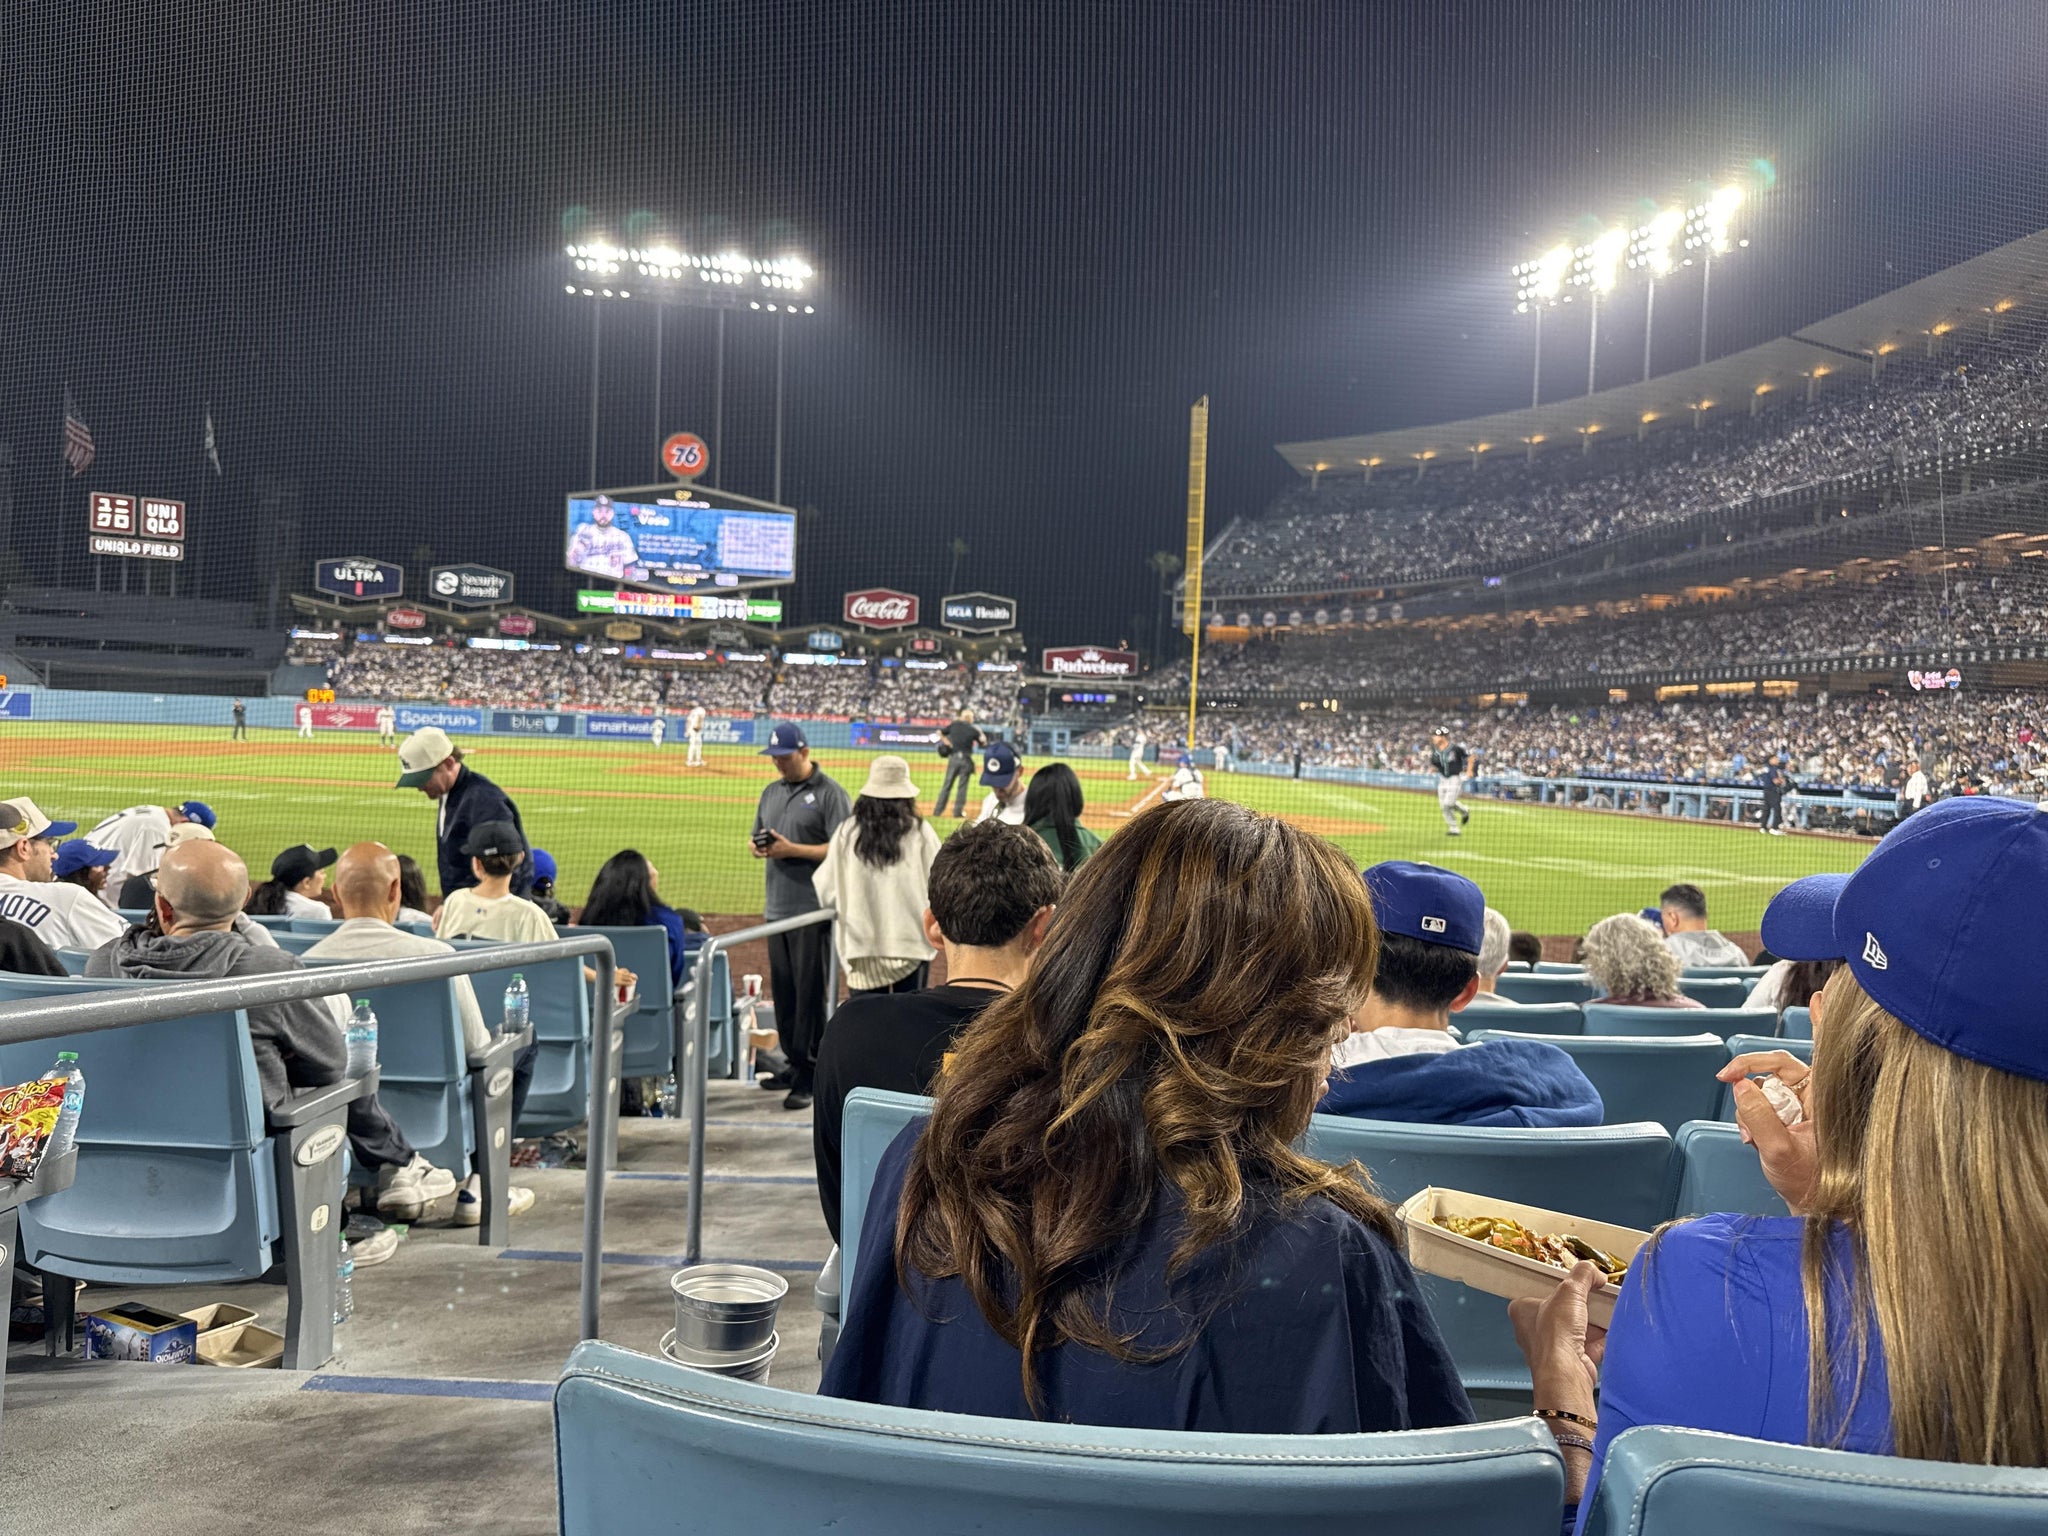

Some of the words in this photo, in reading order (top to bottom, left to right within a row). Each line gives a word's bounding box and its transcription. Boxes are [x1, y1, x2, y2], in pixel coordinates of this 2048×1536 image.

[670, 444, 701, 467] 76
[146, 503, 177, 520] UNI
[146, 517, 180, 534] QLO
[95, 539, 141, 555] UNIQLO
[142, 543, 179, 558] FIELD
[333, 567, 384, 583] ULTRA
[461, 573, 506, 589] Security
[461, 585, 499, 598] Benefit
[946, 606, 973, 618] UCLA
[975, 607, 1010, 620] Health
[1052, 656, 1130, 675] Budweiser
[400, 710, 471, 727] Spectrum
[511, 715, 545, 730] blue
[589, 720, 653, 734] smartwat
